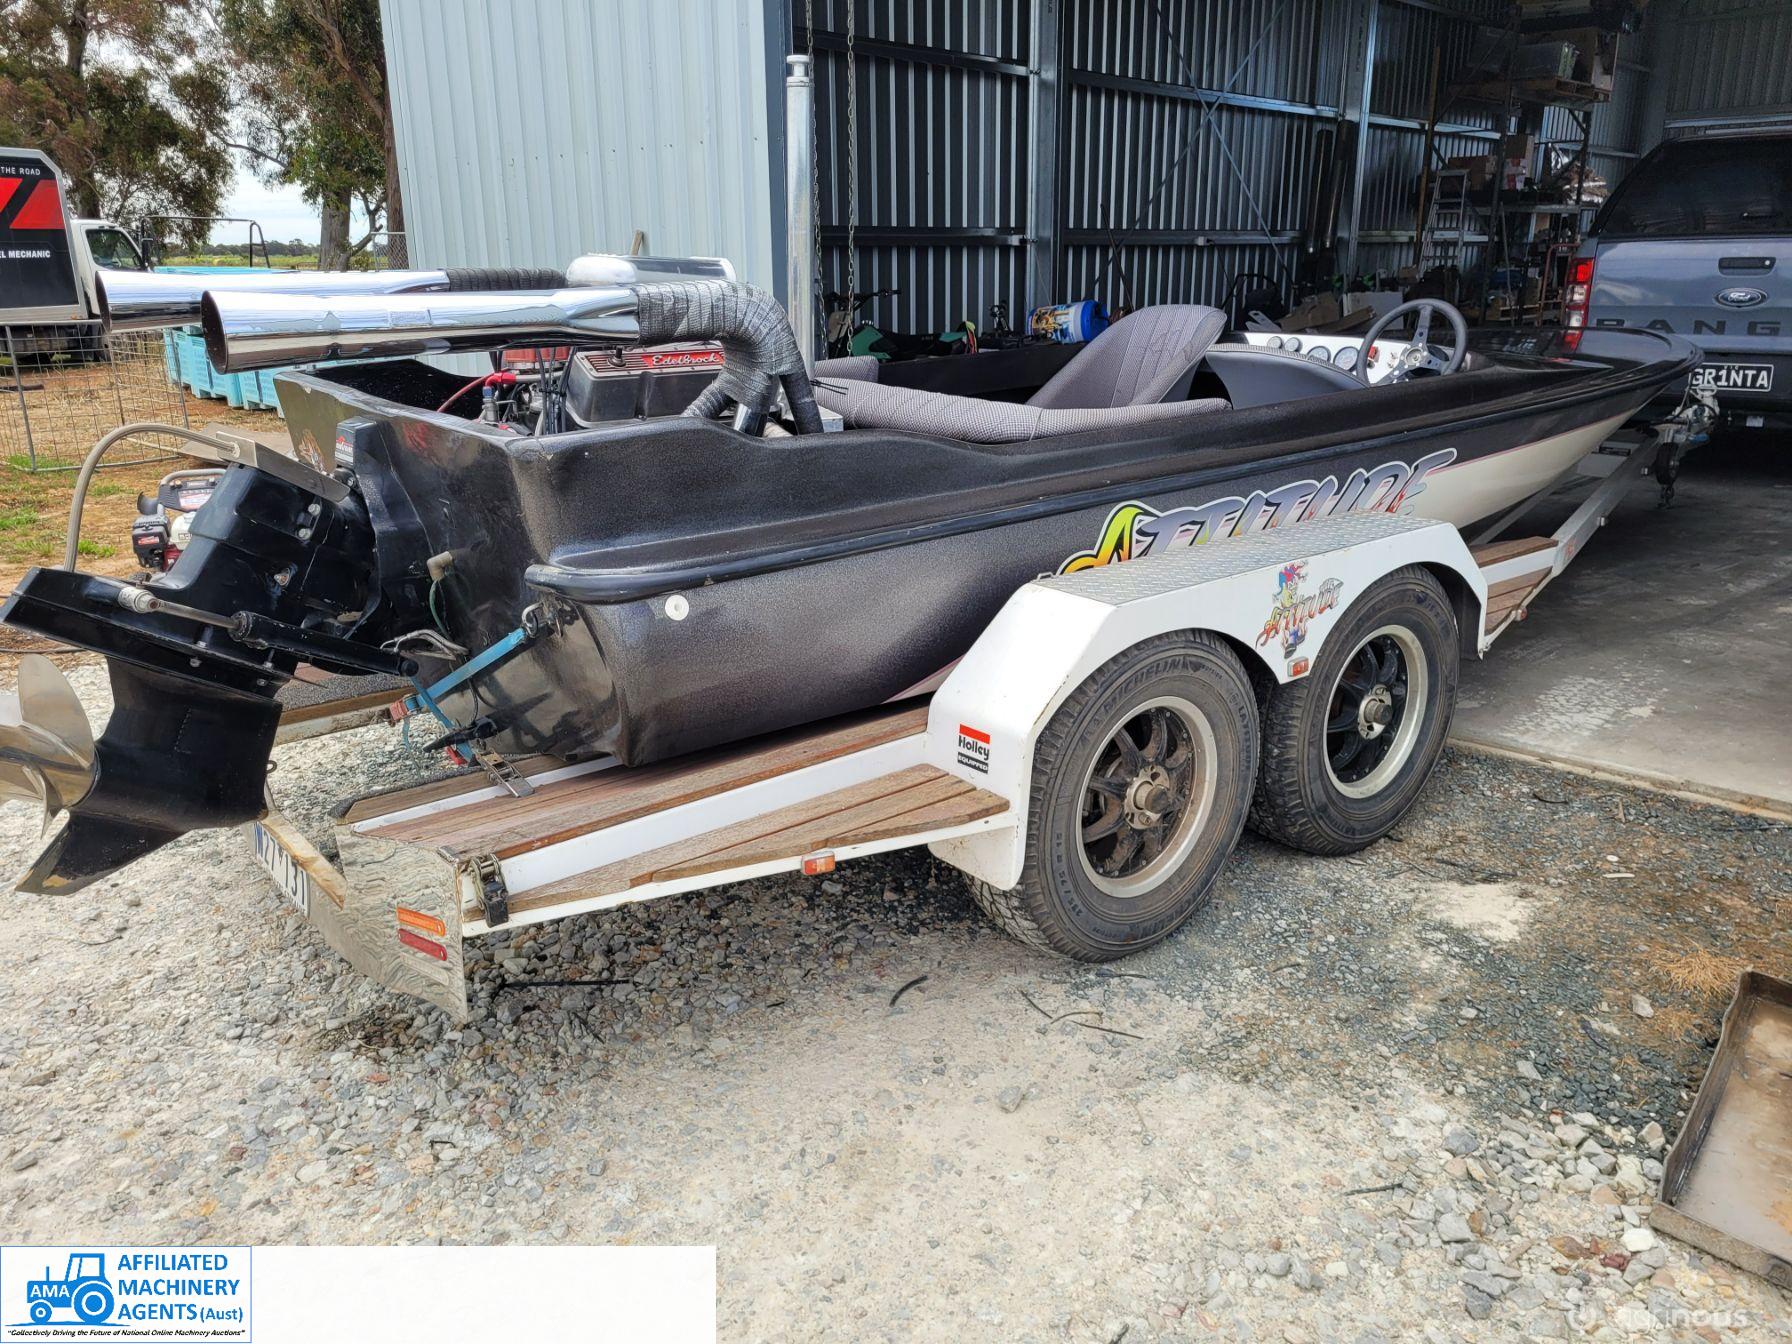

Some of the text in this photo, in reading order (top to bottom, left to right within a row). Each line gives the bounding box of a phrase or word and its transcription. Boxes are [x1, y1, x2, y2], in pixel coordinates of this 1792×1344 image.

[1, 166, 41, 176] THE ROAD
[8, 250, 51, 258] MECHANIC
[652, 352, 720, 366] Edelbrock
[958, 734, 990, 761] Holley
